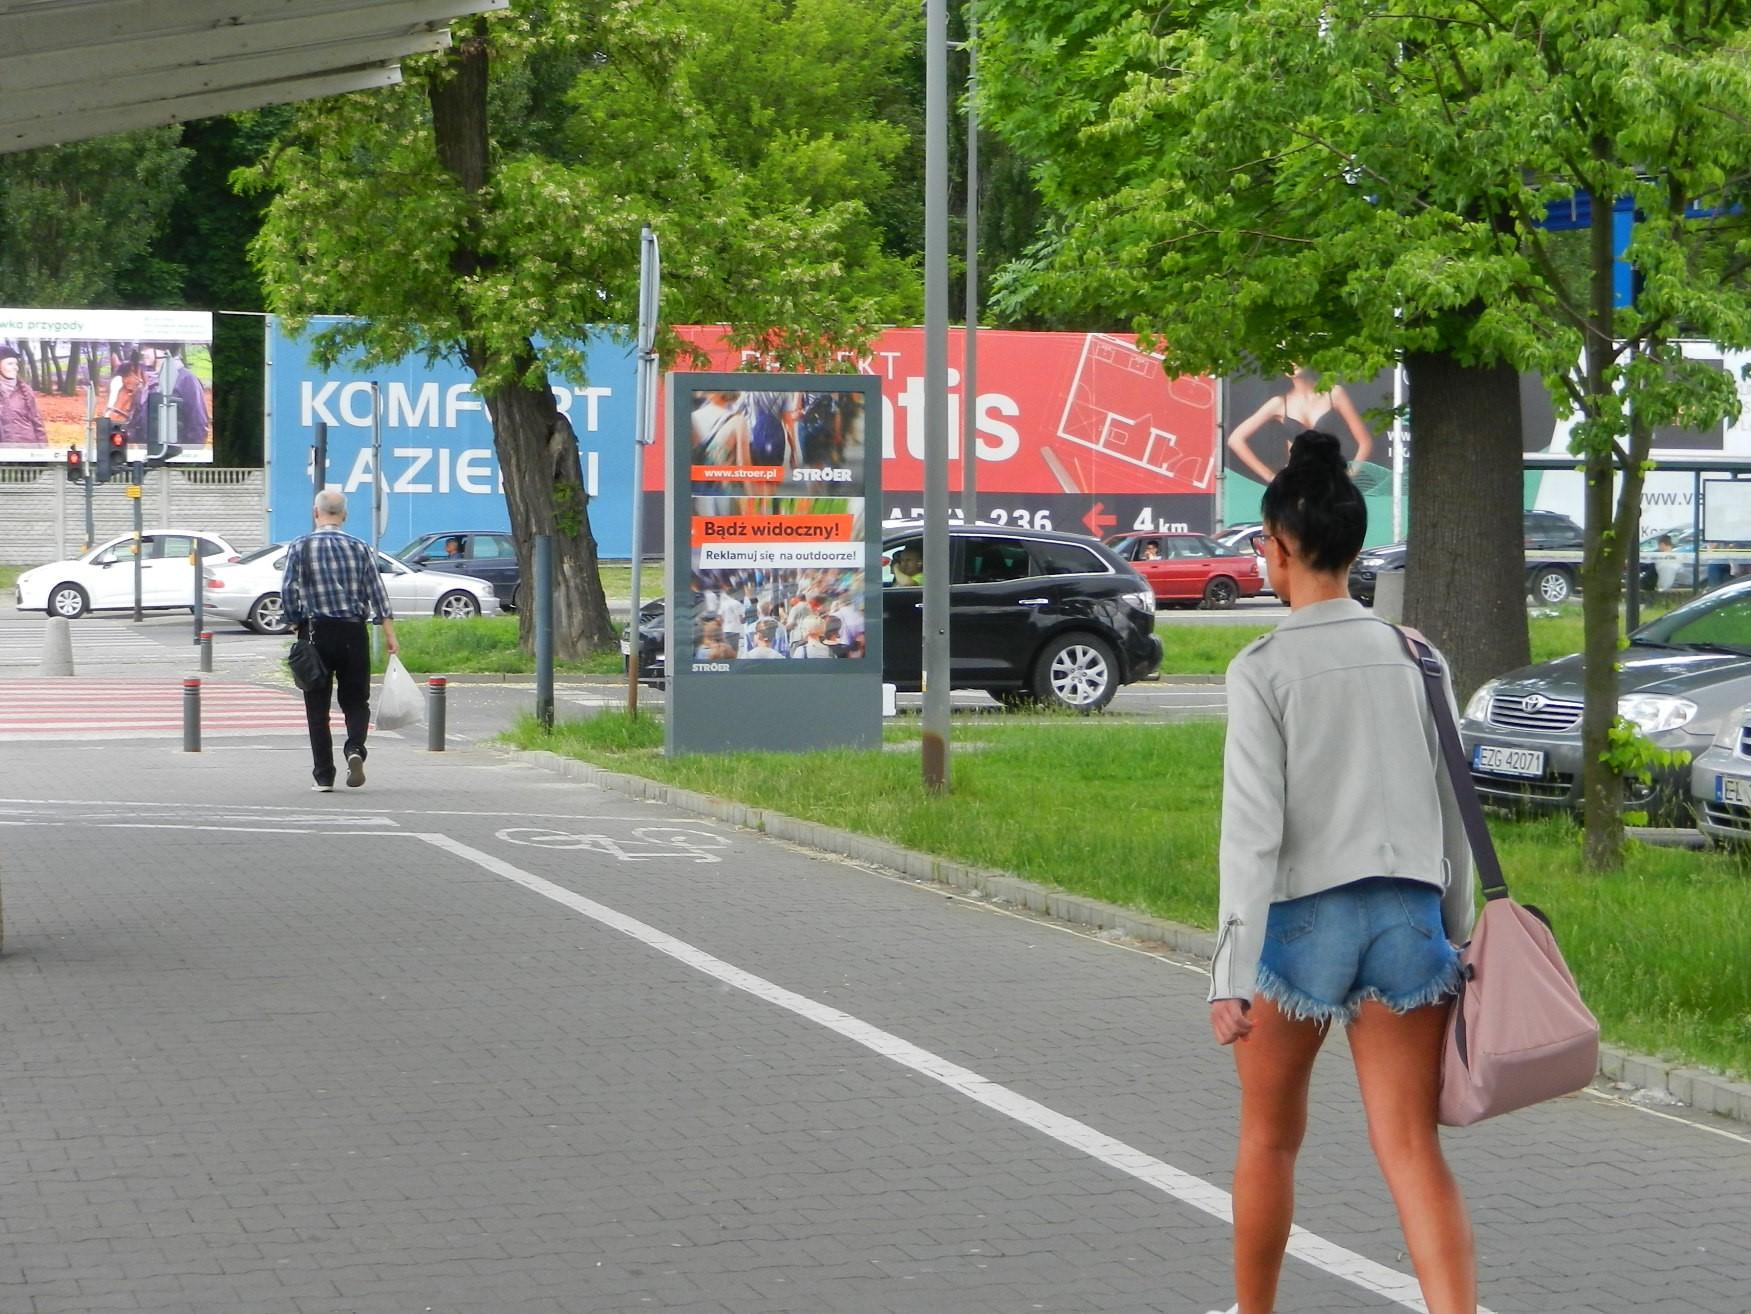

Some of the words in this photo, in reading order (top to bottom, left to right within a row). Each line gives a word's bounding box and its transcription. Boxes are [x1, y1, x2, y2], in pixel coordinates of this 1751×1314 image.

[28, 321, 83, 332] przygody
[301, 381, 612, 431] KOMFT
[307, 447, 599, 496] ŁAZIEI
[704, 469, 777, 479] www.stroer.pl
[1133, 507, 1154, 531] 4
[1159, 518, 1188, 533] km
[752, 522, 839, 540] widoczny!
[706, 551, 757, 563] Reklamuj
[760, 551, 775, 562] się
[796, 551, 856, 561] outdoorze!
[1481, 747, 1502, 767] EZG
[1505, 751, 1541, 772] 42071
